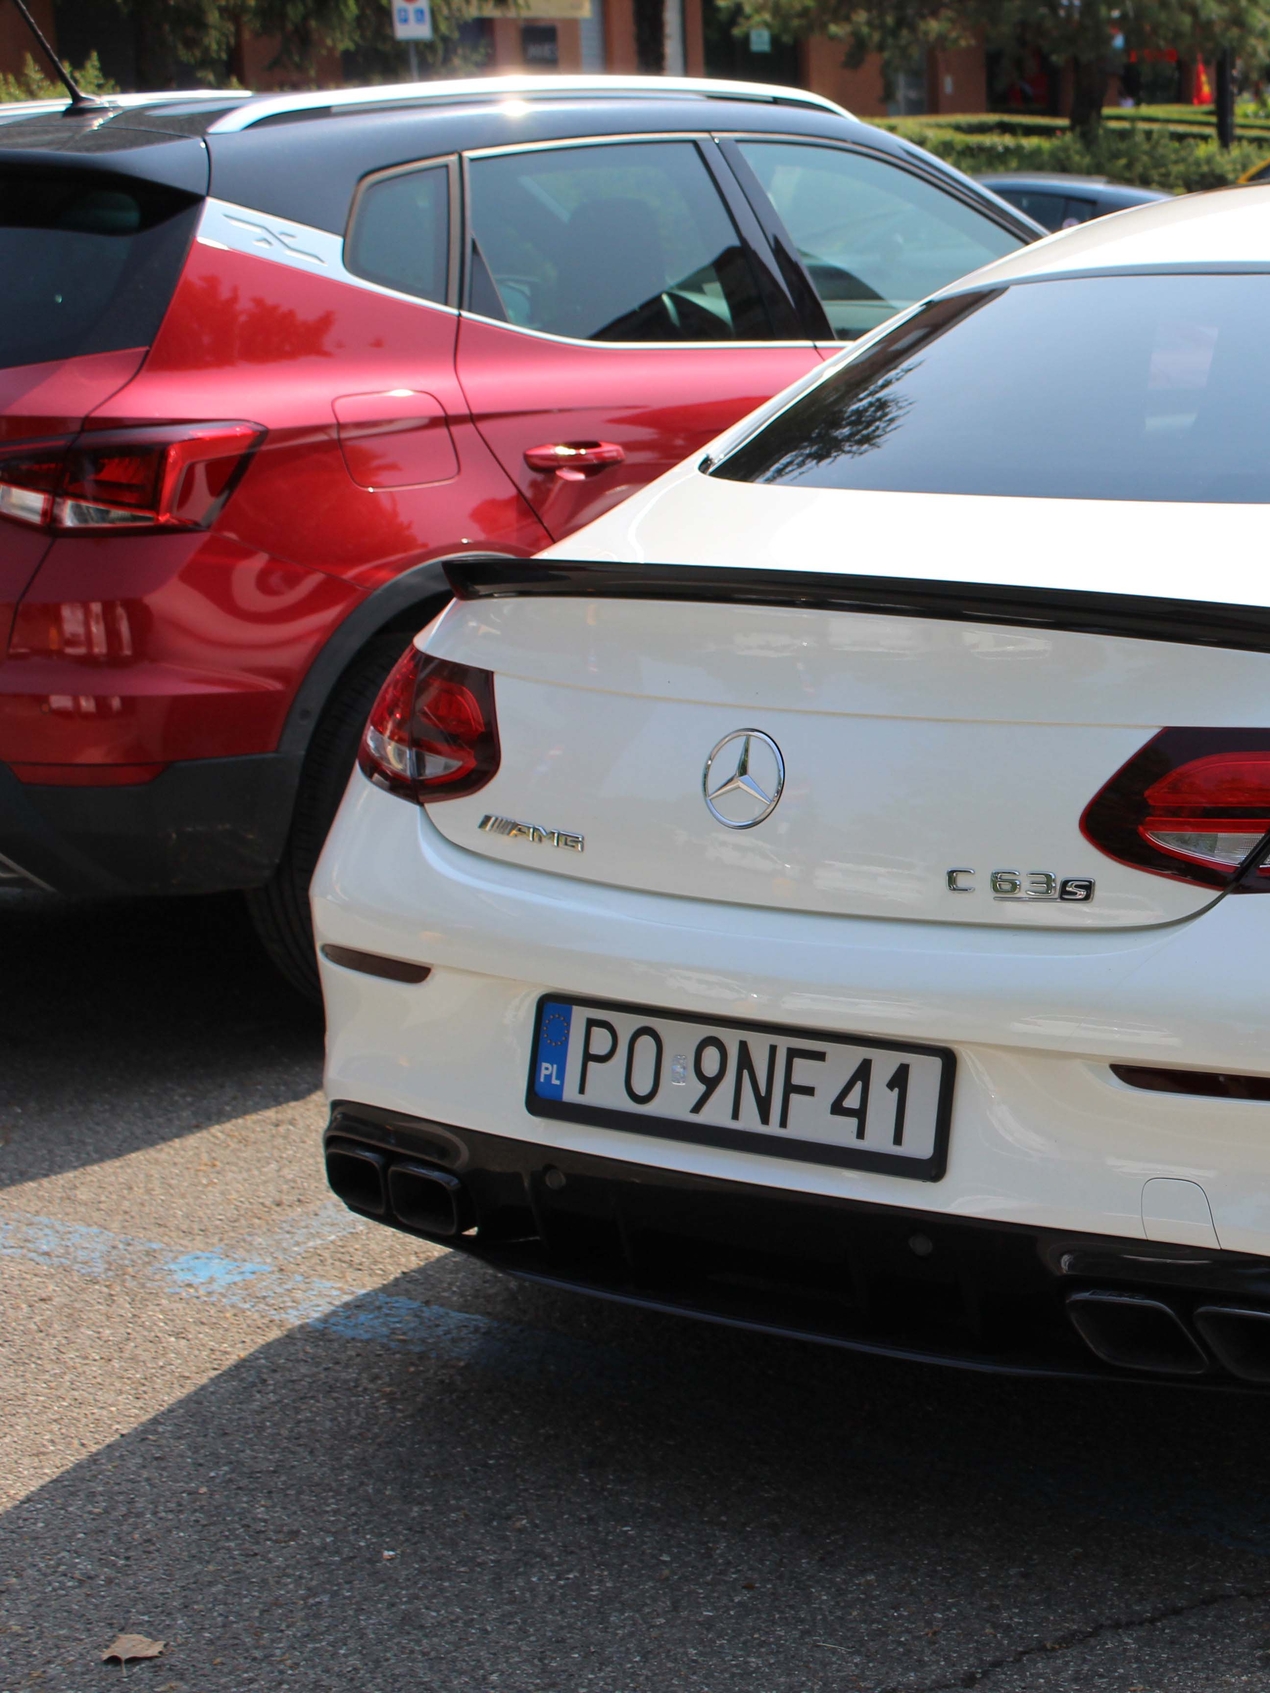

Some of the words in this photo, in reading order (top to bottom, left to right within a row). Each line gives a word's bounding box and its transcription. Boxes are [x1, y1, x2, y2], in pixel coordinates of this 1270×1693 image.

[506, 822, 584, 852] AMG
[946, 867, 976, 893] C
[539, 1061, 561, 1086] PL
[577, 1016, 664, 1106] PO
[689, 1035, 911, 1147] 9NF41
